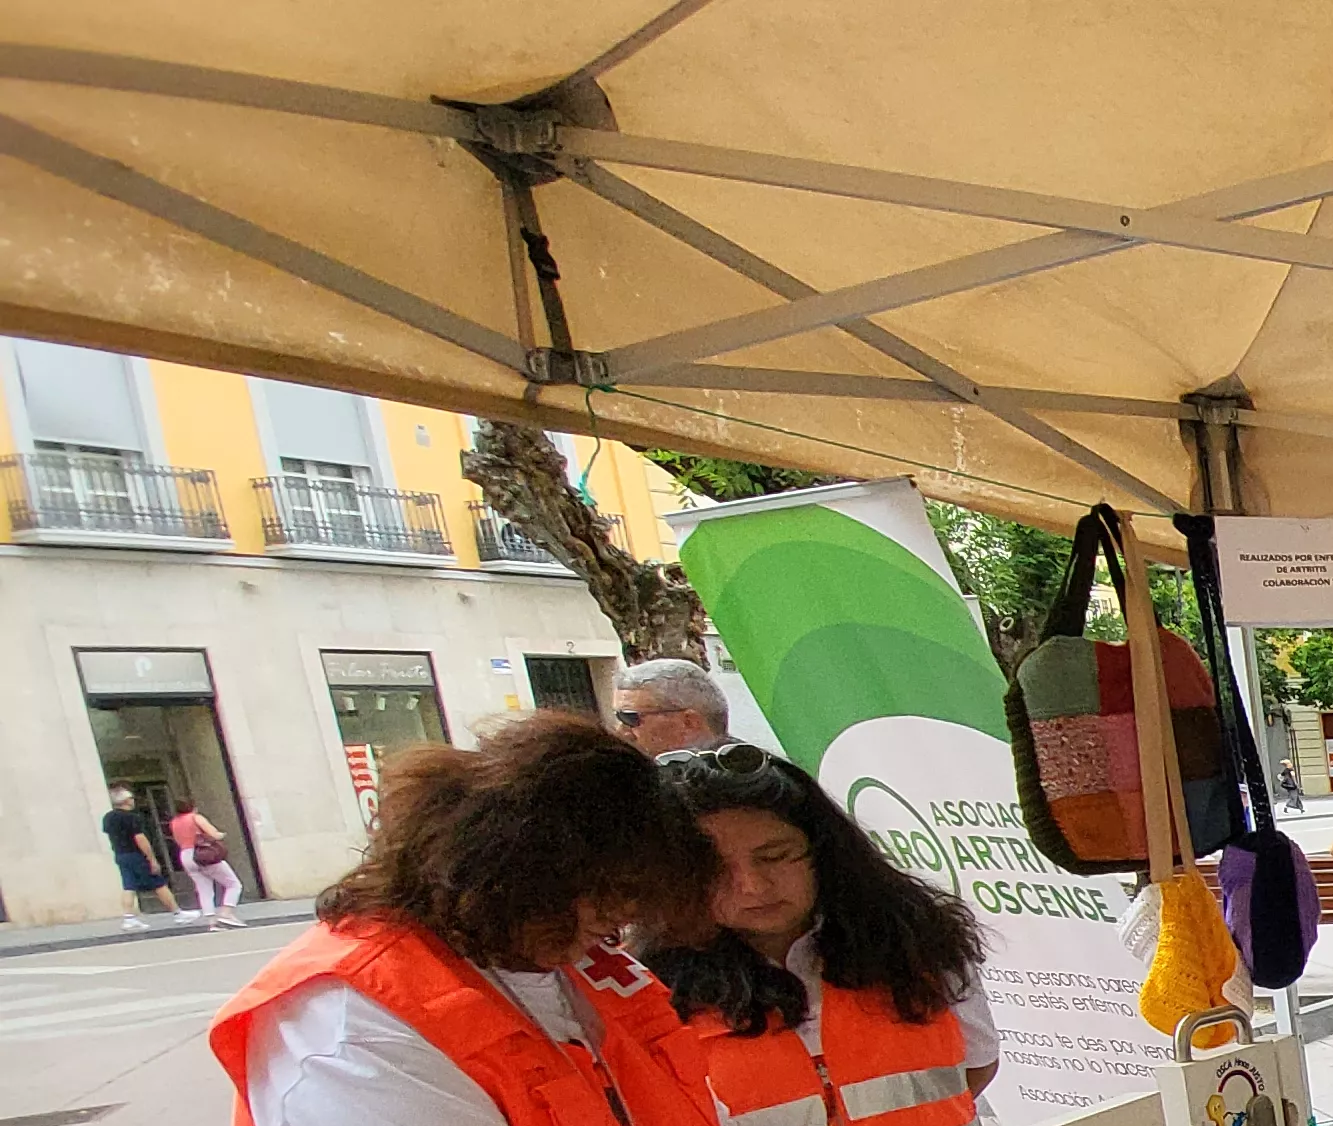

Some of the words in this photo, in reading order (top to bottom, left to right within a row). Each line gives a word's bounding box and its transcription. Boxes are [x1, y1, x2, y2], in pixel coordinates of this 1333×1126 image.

[1239, 553, 1293, 562] REALIZADOS
[1295, 553, 1313, 561] POR
[1290, 565, 1327, 573] ARTRITIS
[1263, 577, 1331, 587] COLABORACIÓN
[930, 801, 1023, 829] ASOCIAC
[972, 880, 1118, 924] OSCENSE
[1026, 971, 1097, 989] personas
[1006, 993, 1026, 1007] no
[1055, 1032, 1074, 1050] te
[1077, 1036, 1108, 1053] des
[1109, 1038, 1136, 1057] por
[1004, 1049, 1062, 1071] nosotros
[1062, 1059, 1085, 1073] no
[1087, 1057, 1103, 1075] lo
[1018, 1083, 1094, 1109] Asociación
